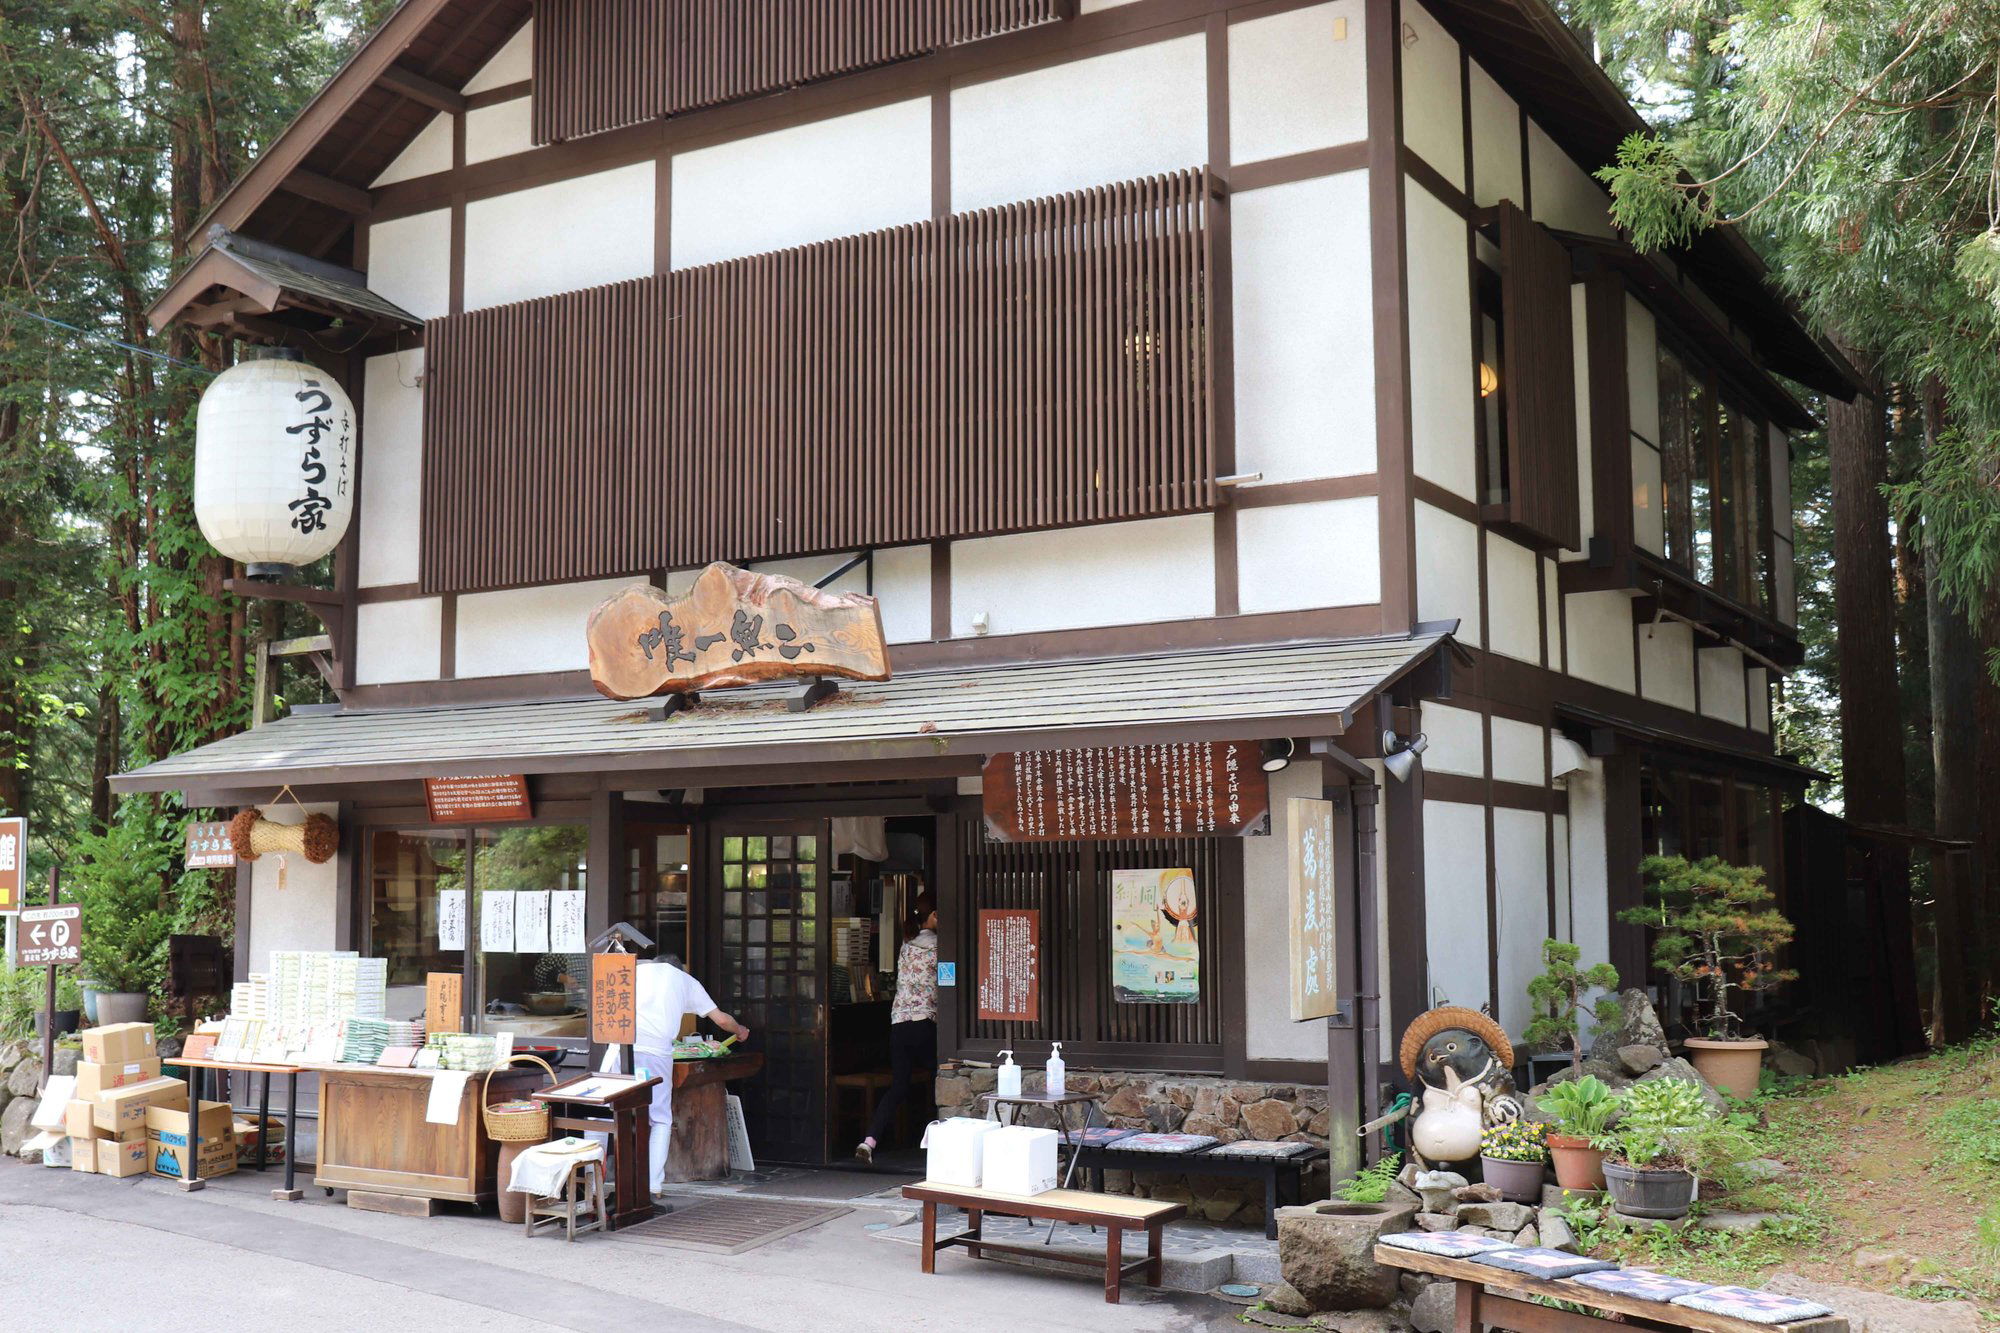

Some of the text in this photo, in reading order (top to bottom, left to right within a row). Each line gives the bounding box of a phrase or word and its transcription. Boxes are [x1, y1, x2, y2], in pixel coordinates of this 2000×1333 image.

[285, 379, 333, 534] うずら家
[1225, 744, 1241, 825] 戸隠そばの由来
[41, 945, 79, 962] うずら家
[56, 925, 65, 942] P
[606, 972, 616, 1029] 10時30分
[617, 965, 632, 1036] 支度中
